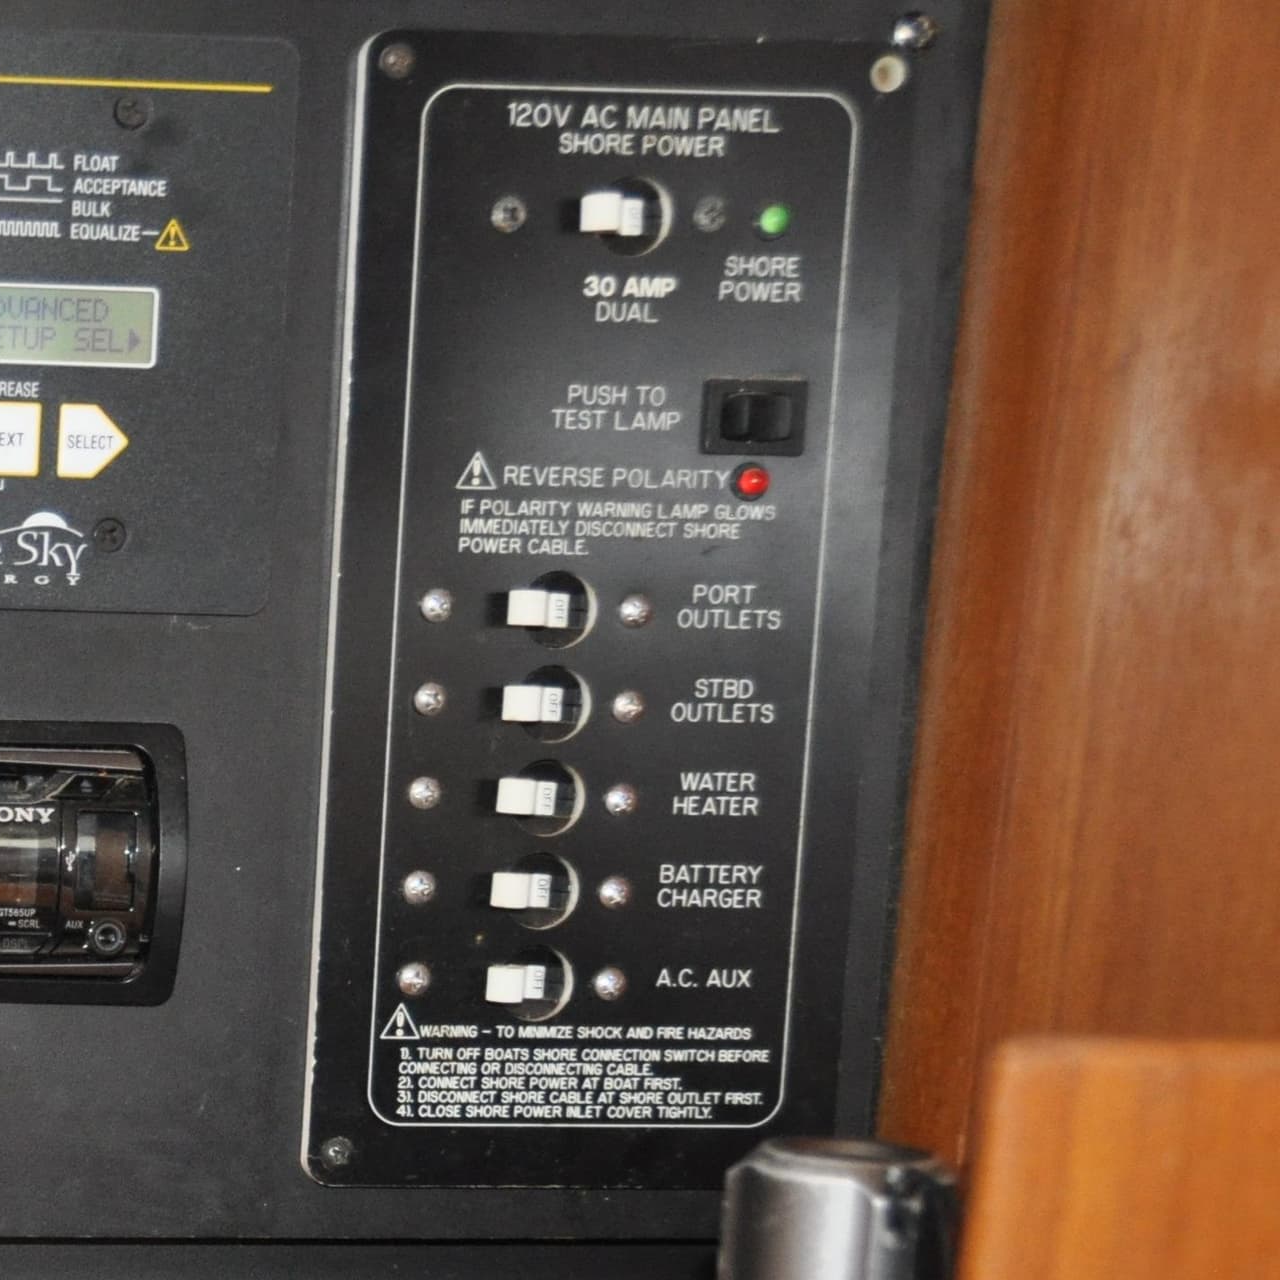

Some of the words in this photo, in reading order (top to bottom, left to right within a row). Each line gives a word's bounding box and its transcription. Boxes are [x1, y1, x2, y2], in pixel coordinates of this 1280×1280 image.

[507, 101, 571, 129] 120V
[579, 104, 619, 130] AC
[624, 105, 691, 132] MAIN
[697, 106, 780, 134] PANEL
[559, 133, 635, 156] SHORE
[641, 134, 726, 158] POWER
[73, 153, 120, 172] FLOAT
[72, 177, 167, 197] ACCEPTANCE
[71, 199, 111, 218] BULK
[70, 222, 141, 242] EQUALIZE
[724, 255, 801, 279] SHORE
[582, 274, 617, 298] 30
[621, 276, 677, 298] AMP
[718, 279, 802, 303] POWER
[595, 300, 659, 324] DUAL
[74, 327, 123, 353] SEL
[567, 383, 628, 406] PUSH
[635, 385, 667, 408] TO
[551, 408, 608, 431] TEST
[613, 410, 681, 432] LAMP
[67, 433, 115, 451] SELECT
[503, 465, 605, 488] REVERSE
[612, 467, 731, 490] POLARITY
[459, 498, 474, 515] IF
[478, 499, 573, 517] POLARITY
[575, 501, 653, 519] WARNING
[657, 503, 709, 519] LAMP
[713, 503, 778, 521] GLOWS
[459, 519, 571, 537] IMMEDIATELY
[574, 521, 678, 539] DISCONNECT
[683, 522, 742, 539] SHORE
[458, 536, 522, 554] POWER
[527, 537, 589, 556] CABLE.
[692, 583, 757, 605] PORT
[677, 608, 782, 630] OUTLETS
[694, 678, 755, 700] STBD
[670, 701, 775, 724] OUTLETS
[680, 771, 756, 793] WATER
[672, 795, 759, 817] HEATER
[659, 863, 763, 885] BATTERY
[656, 887, 762, 909] CHARGER
[655, 967, 698, 988] A.C.
[705, 968, 752, 989] AUX
[418, 1024, 479, 1040] WARNING
[495, 1024, 516, 1039] TO
[517, 1025, 574, 1039] MINIMIZE
[576, 1025, 623, 1040] SHOCK
[625, 1026, 655, 1040] AND
[656, 1026, 685, 1040] FIRE
[687, 1026, 753, 1041] HAZARDS
